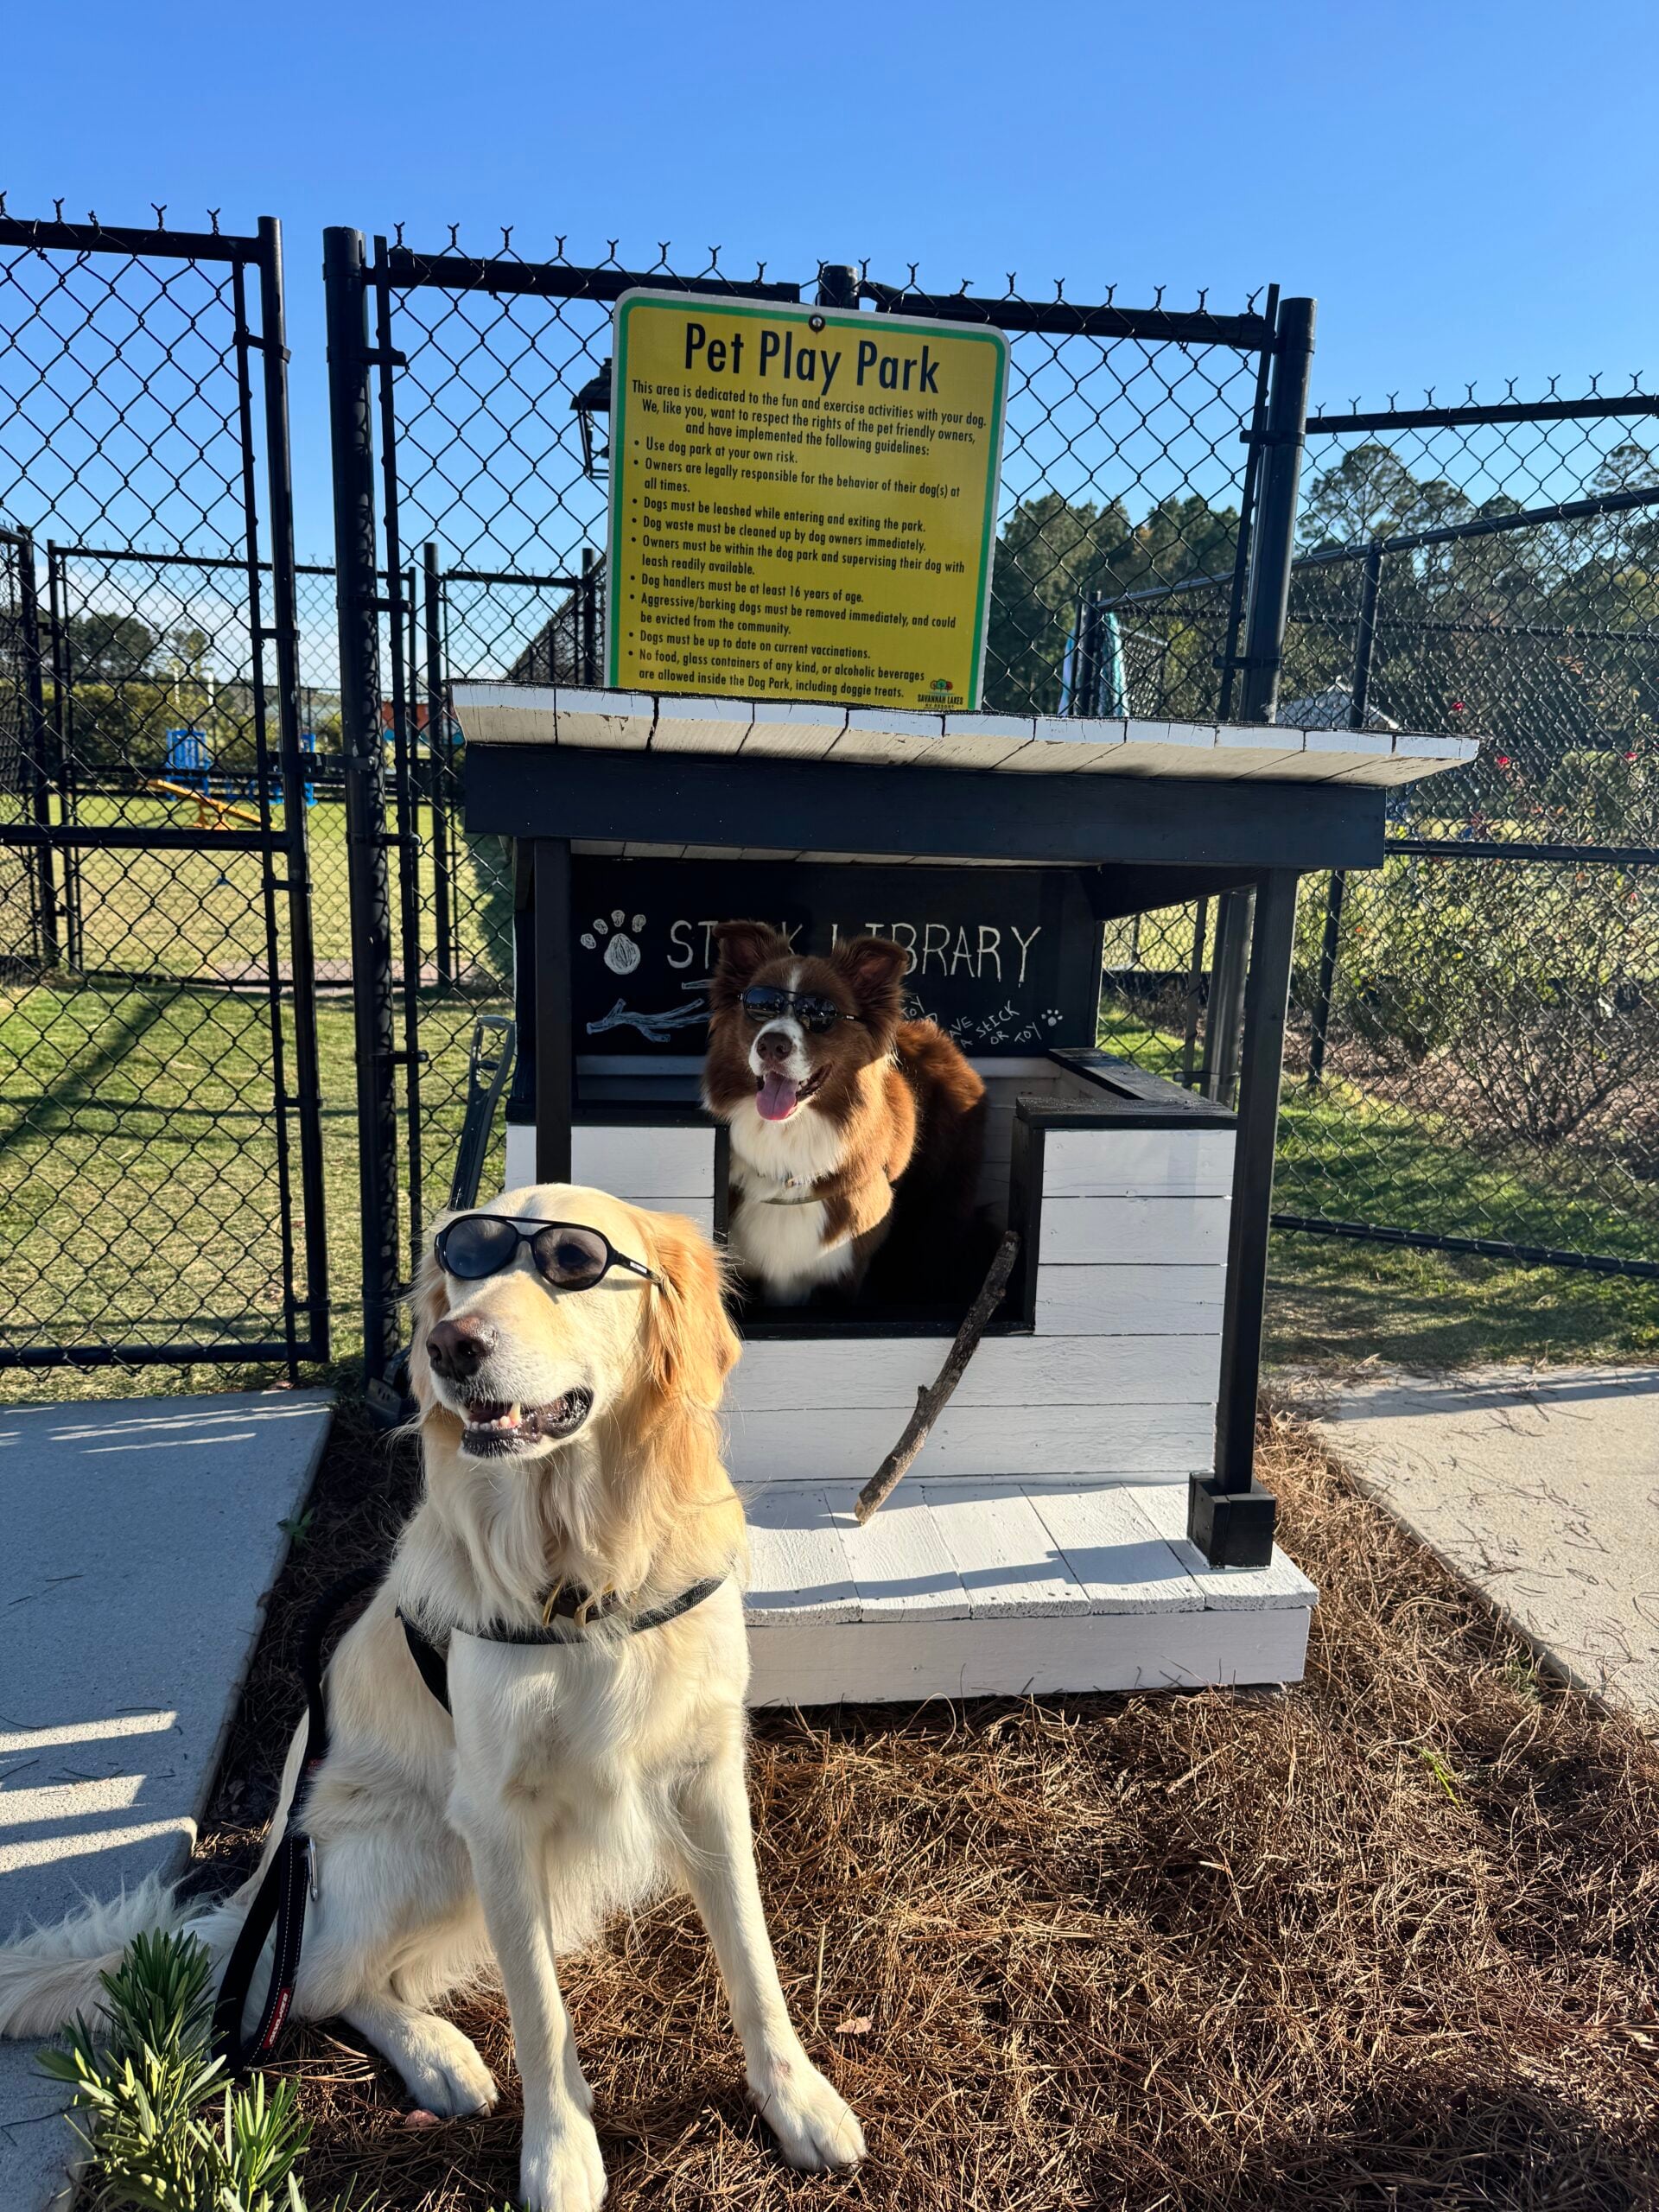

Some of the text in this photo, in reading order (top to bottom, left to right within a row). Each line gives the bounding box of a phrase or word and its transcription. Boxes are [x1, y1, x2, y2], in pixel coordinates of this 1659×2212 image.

[684, 321, 939, 396] Pet Play Park
[632, 378, 986, 429] This area is dedicated to the fun and exercise activities with your dog.
[642, 397, 975, 444] We, like you, want to respect the rights of the pet friendly owners,
[645, 435, 798, 463] Use dog park at your own risk.
[685, 421, 929, 455] and have implemented the following guidelines:
[644, 476, 690, 492] all times.
[645, 456, 960, 499] Owners are legally responsible for the behavior of their dog(s) at
[644, 496, 925, 533] Dogs must be leashed while entering and exiting the park.
[643, 514, 925, 554] Dog waste must be cleaned up by dog owners immediately.
[642, 534, 964, 574] Owners must be within the dog park and supervising their dog with
[642, 553, 754, 575] leash readily available.
[641, 572, 863, 605] Dog handlers must be at least 16 years of age.
[639, 610, 791, 637] be evicted from the community.
[640, 592, 956, 628] Aggressive/barking dogs must be removed immediately, and could
[639, 629, 870, 658] Dogs must be up to date on current vaccinations.
[639, 648, 925, 683] No food, glass containers of any kind, or alcoholic beverages
[639, 668, 904, 697] are allowed inside the Dog Park, including doggie treats.
[918, 694, 963, 705] SAVANNAH LAKES
[666, 919, 804, 969] STK
[960, 1039, 974, 1049] A
[990, 1021, 1042, 1045] OR TOY
